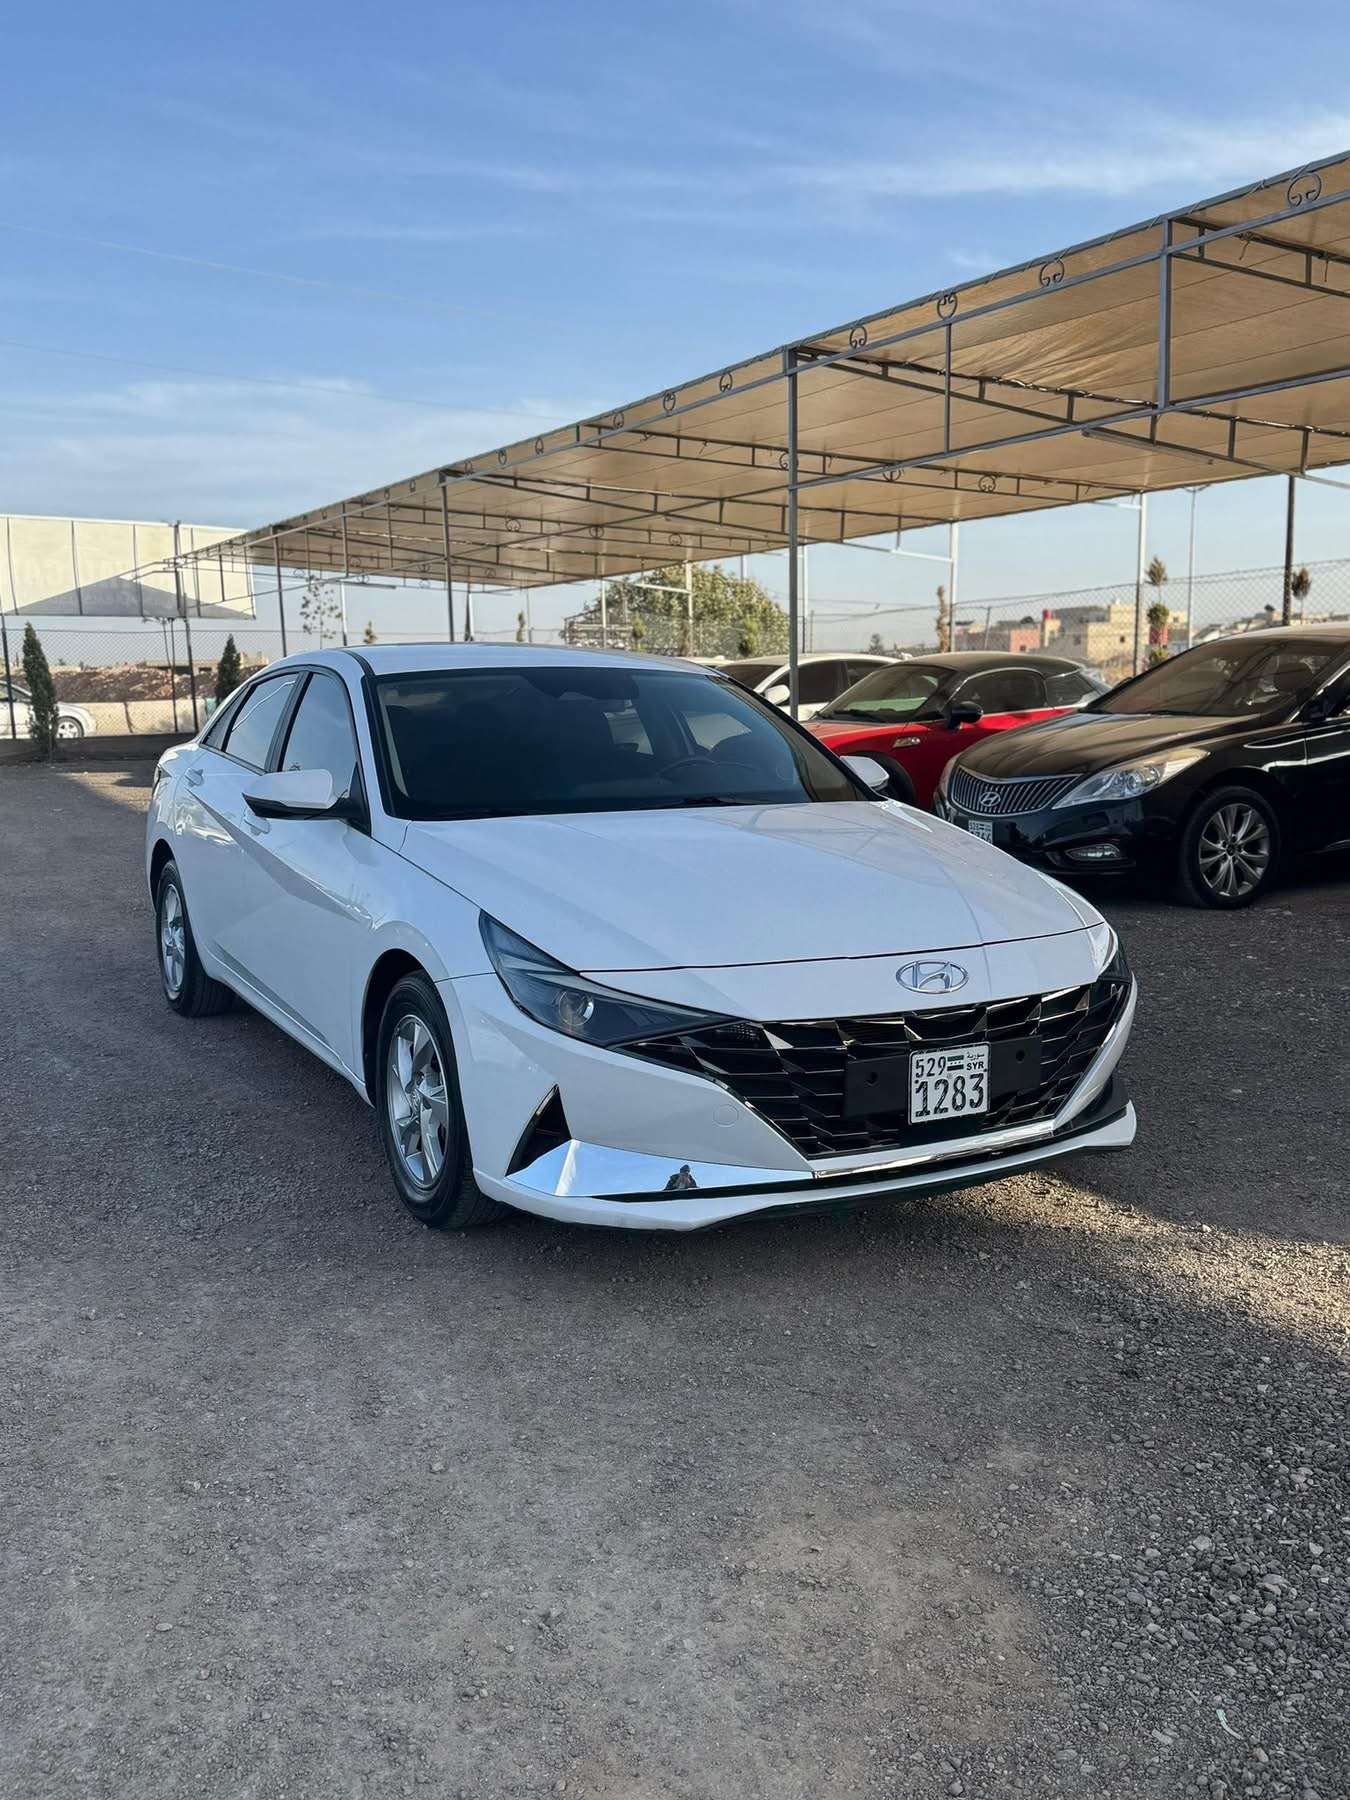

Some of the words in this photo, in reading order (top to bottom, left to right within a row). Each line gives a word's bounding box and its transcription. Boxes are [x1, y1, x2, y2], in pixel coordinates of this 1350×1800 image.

[915, 1056, 946, 1078] 529
[966, 1061, 984, 1071] SYR
[915, 1073, 984, 1117] 1283
